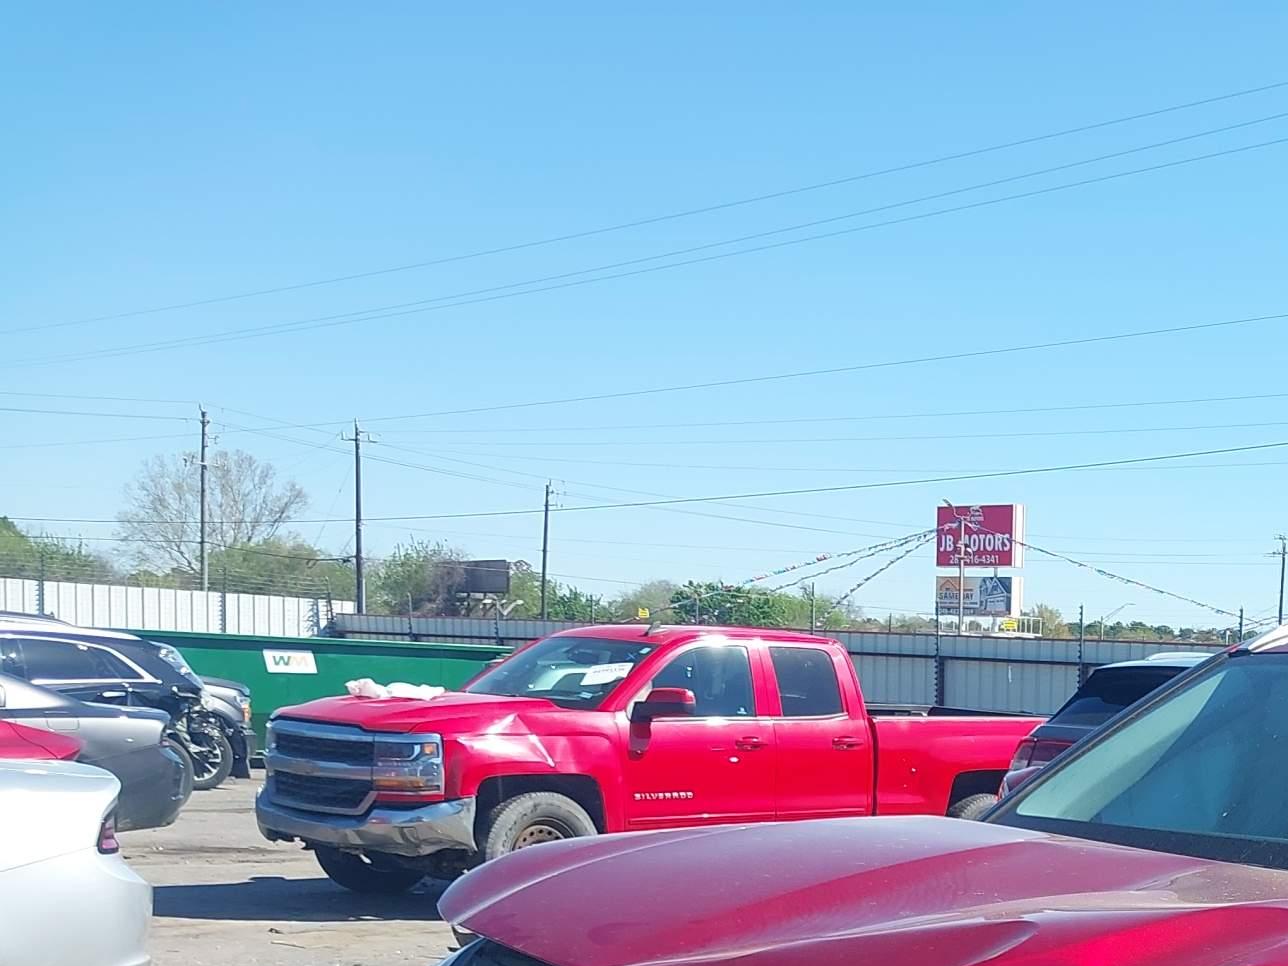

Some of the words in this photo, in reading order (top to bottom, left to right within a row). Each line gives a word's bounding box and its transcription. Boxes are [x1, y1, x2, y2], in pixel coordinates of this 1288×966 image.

[940, 534, 954, 552] JB
[272, 655, 309, 667] WM
[634, 791, 693, 800] SILVERADO
